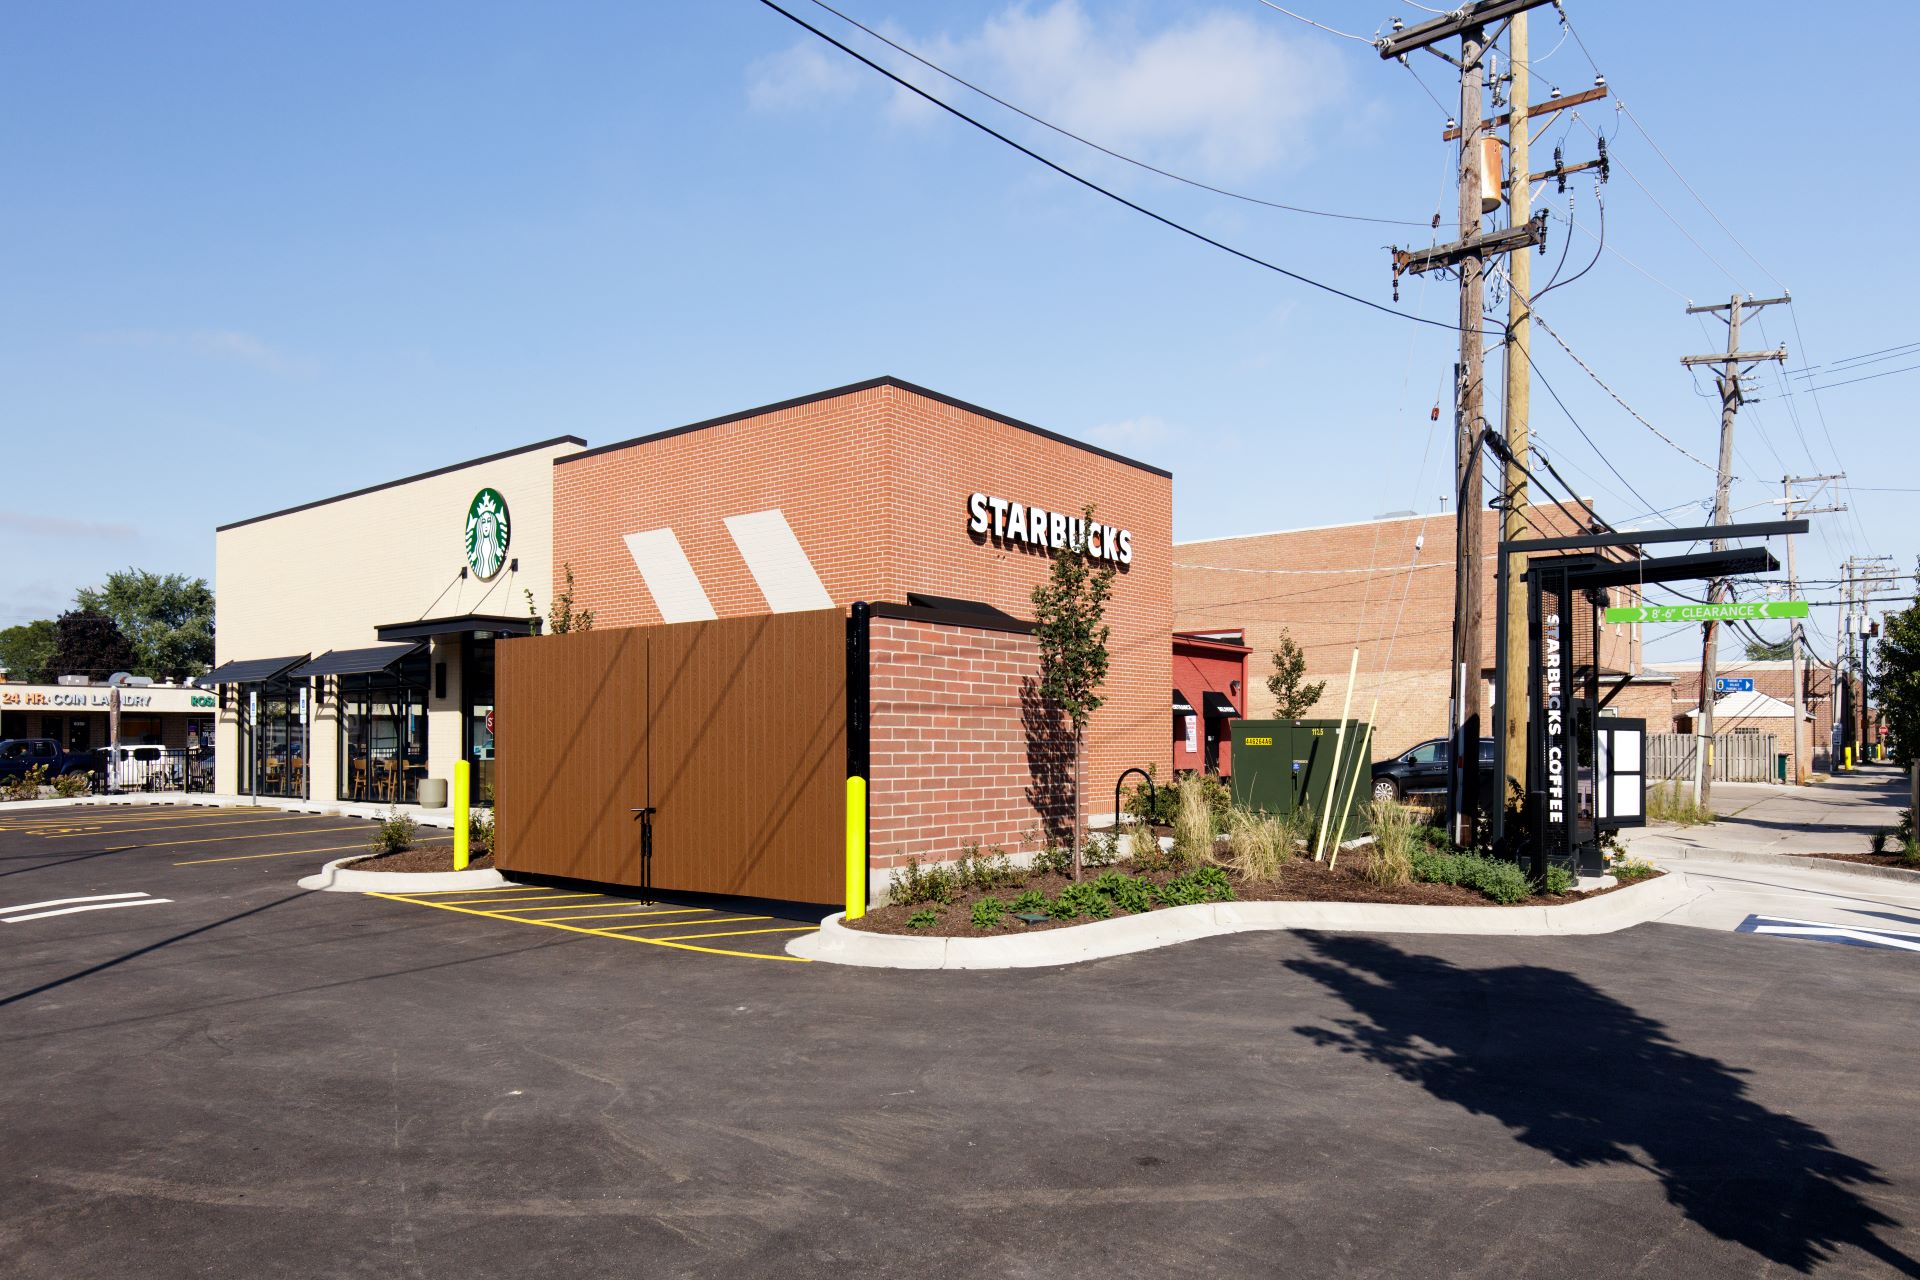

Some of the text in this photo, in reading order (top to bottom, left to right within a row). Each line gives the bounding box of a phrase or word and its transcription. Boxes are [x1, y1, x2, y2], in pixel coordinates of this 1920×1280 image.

[969, 492, 1132, 565] STARBUCKS
[1682, 605, 1754, 618] CLEARANCE
[2, 693, 20, 705] 24
[54, 694, 87, 706] COIN
[91, 694, 152, 707] LANDRY
[1546, 614, 1563, 823] STARBUCKS COFFEE
